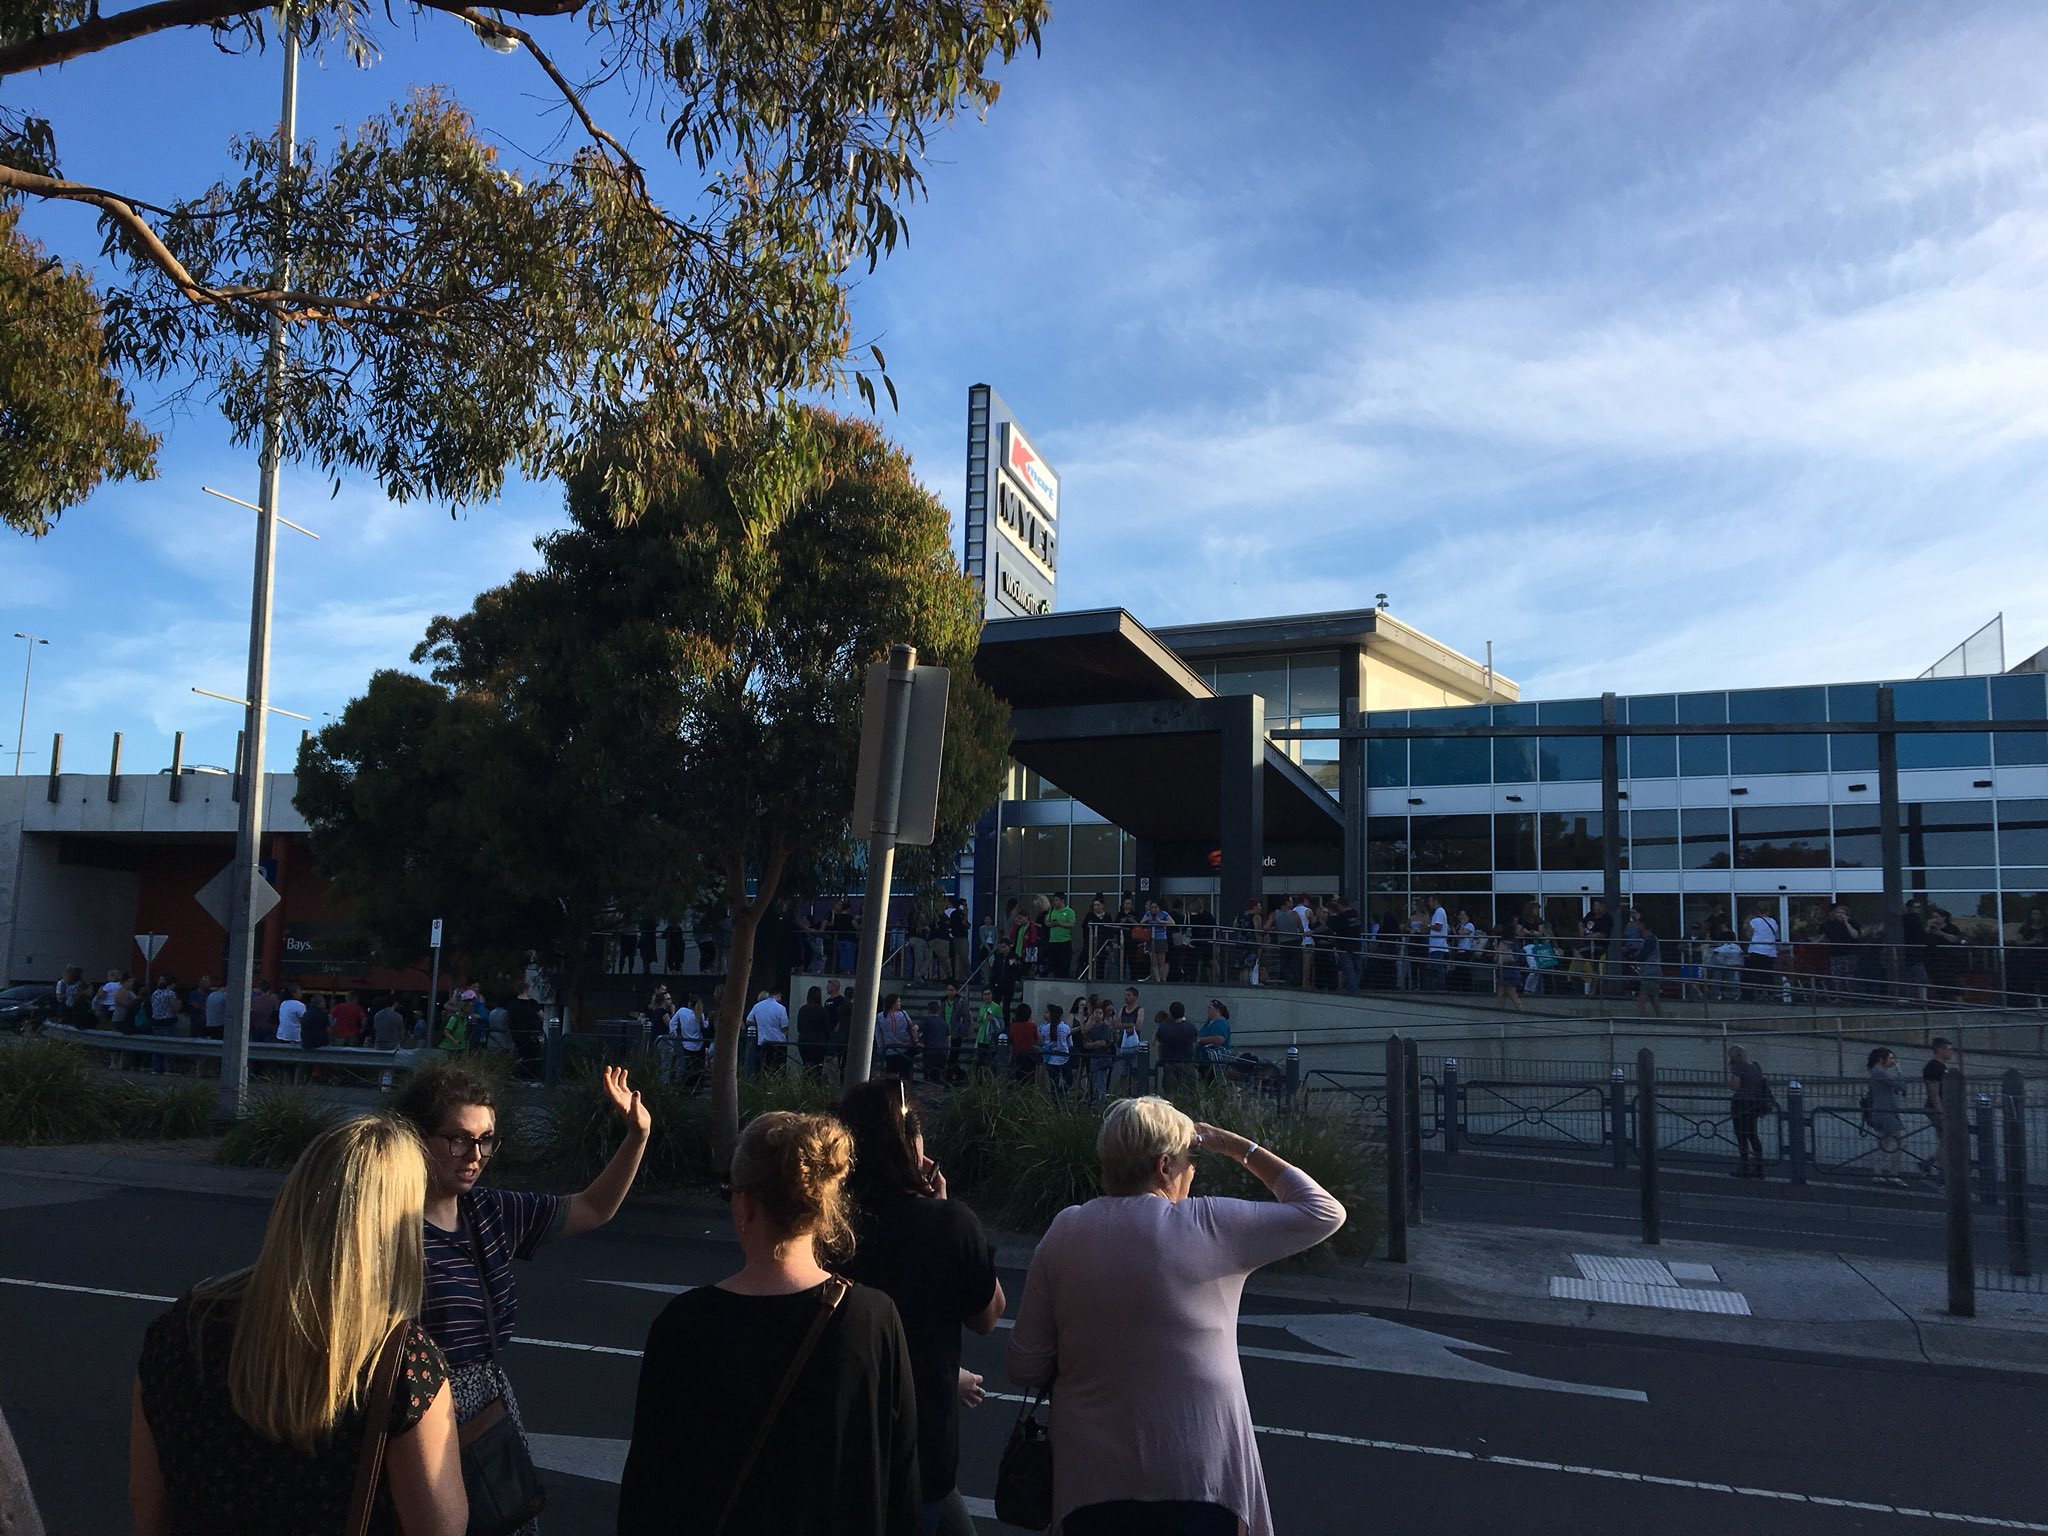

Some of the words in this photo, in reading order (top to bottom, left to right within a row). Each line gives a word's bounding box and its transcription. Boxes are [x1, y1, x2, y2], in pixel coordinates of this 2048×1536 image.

[1010, 434, 1055, 501] Kmart
[1000, 482, 1057, 572] MYER
[1261, 855, 1277, 867] ide
[286, 937, 313, 952] Bays
